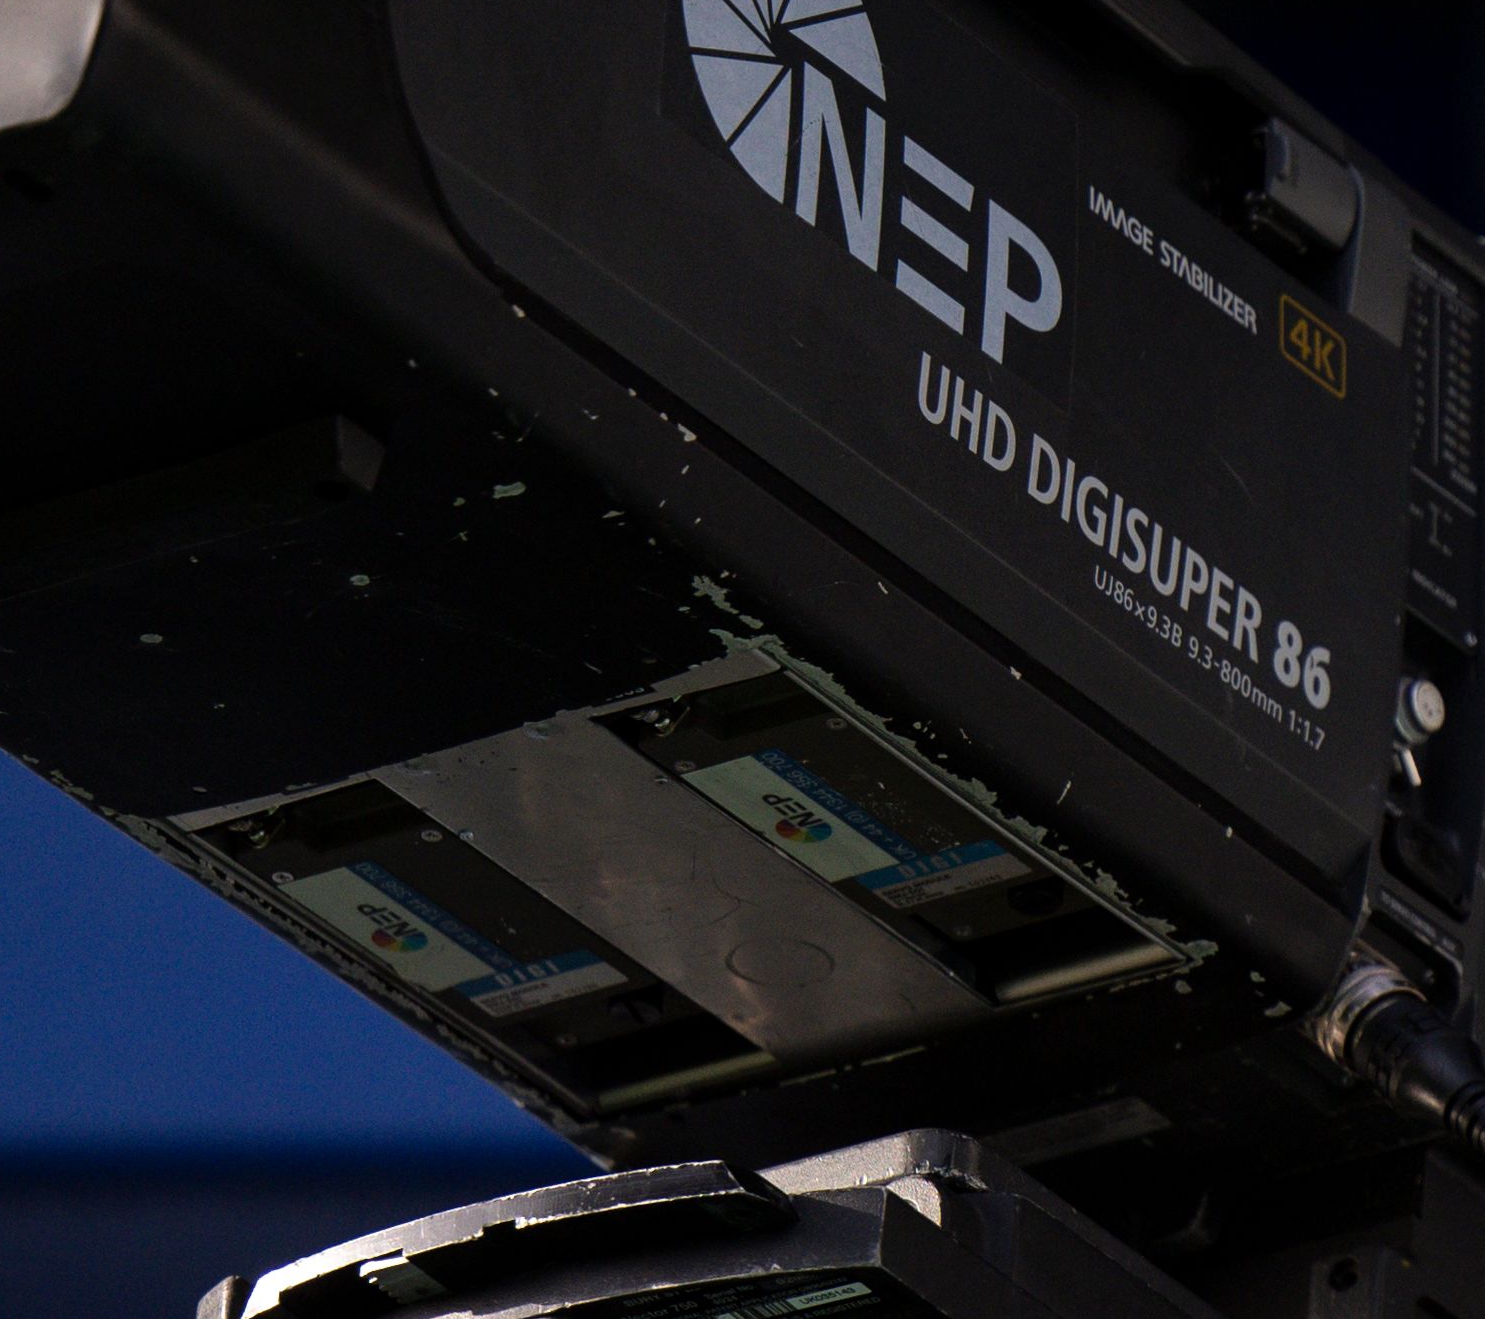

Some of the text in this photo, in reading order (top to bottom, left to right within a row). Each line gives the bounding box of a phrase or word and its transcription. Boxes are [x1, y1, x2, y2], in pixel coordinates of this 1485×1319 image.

[796, 61, 1062, 364] NEP
[1089, 185, 1257, 335] IMAGE STABILIZER
[1290, 318, 1335, 381] 4K
[918, 351, 1331, 710] UHD DIGISUPER 86
[1188, 636, 1283, 723] 9.3-800mm
[1289, 710, 1326, 750] 1:1.7
[762, 794, 824, 827] NEP
[357, 903, 418, 937] NEP
